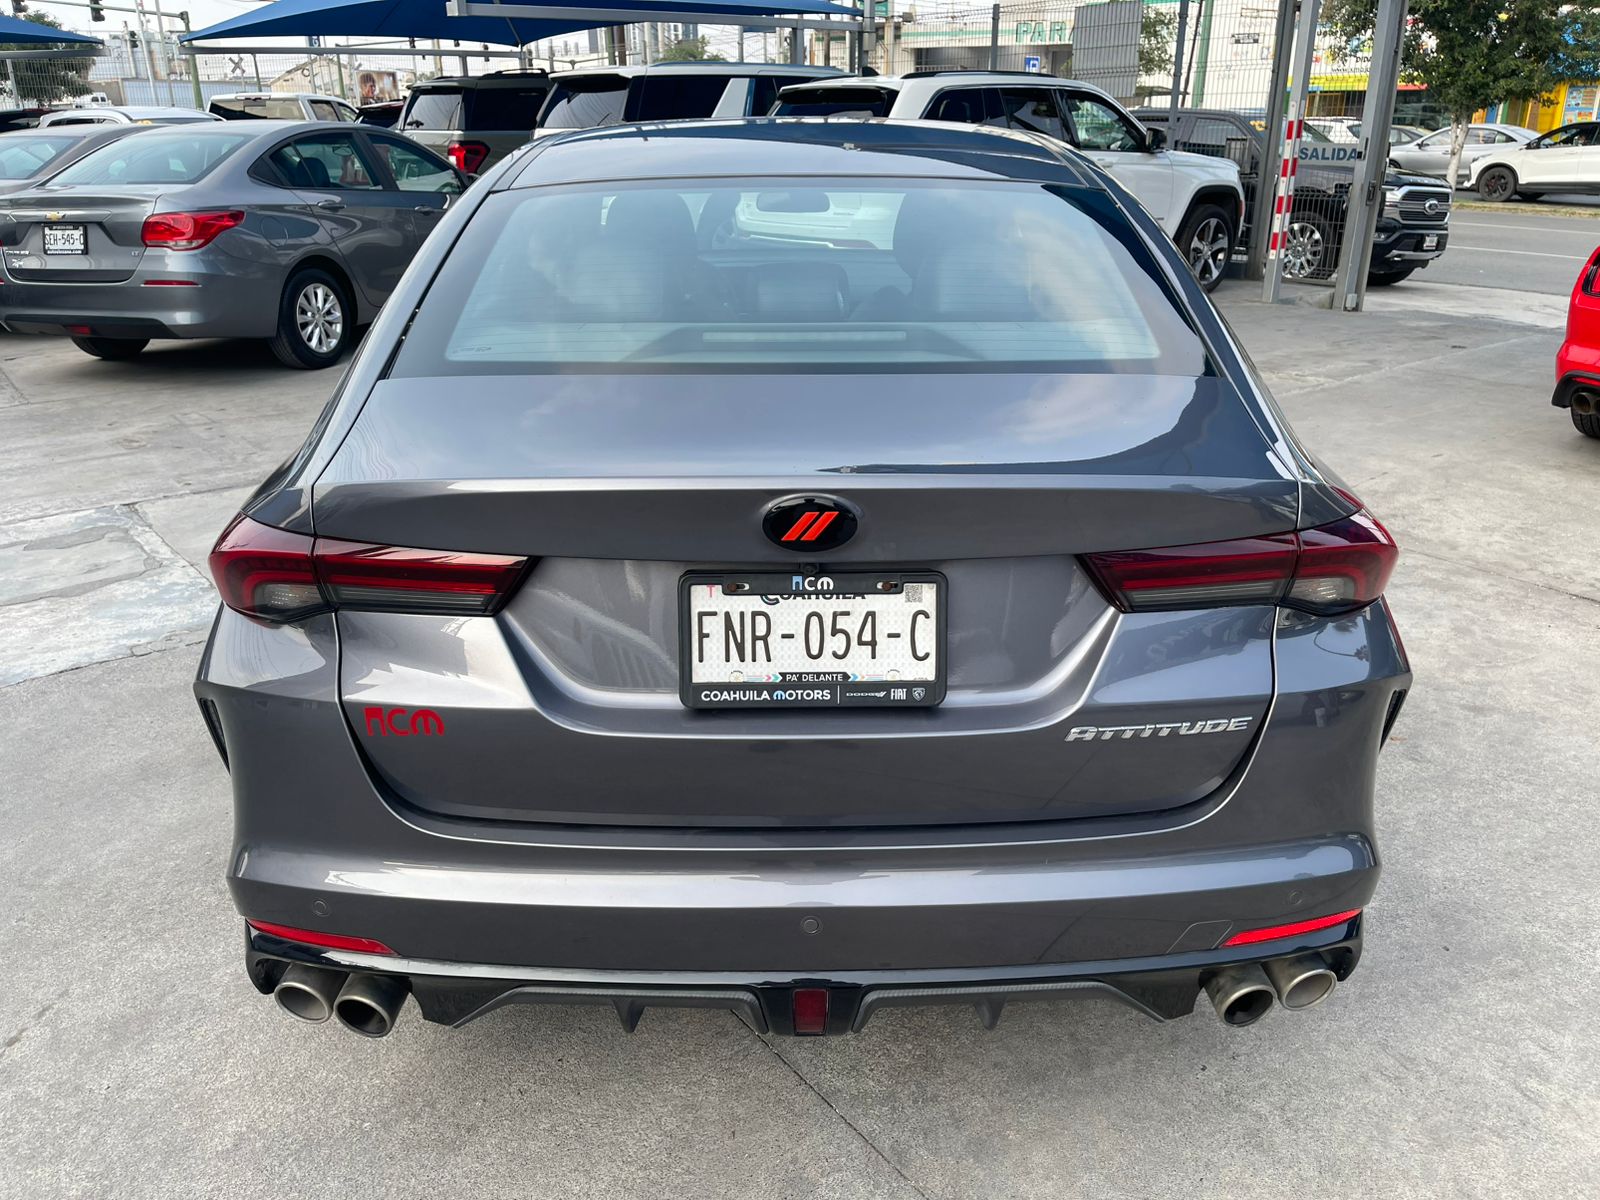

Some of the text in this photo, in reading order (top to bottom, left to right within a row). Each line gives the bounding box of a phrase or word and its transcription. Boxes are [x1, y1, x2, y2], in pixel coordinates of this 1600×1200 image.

[1016, 21, 1073, 43] PAR
[1299, 147, 1357, 161] SALIDA
[697, 609, 931, 663] FNR-054-C
[802, 674, 843, 682] DELANTE
[701, 690, 771, 701] COAHUILA
[890, 688, 907, 700] FIAT
[1064, 716, 1253, 742] ATTITUDE
